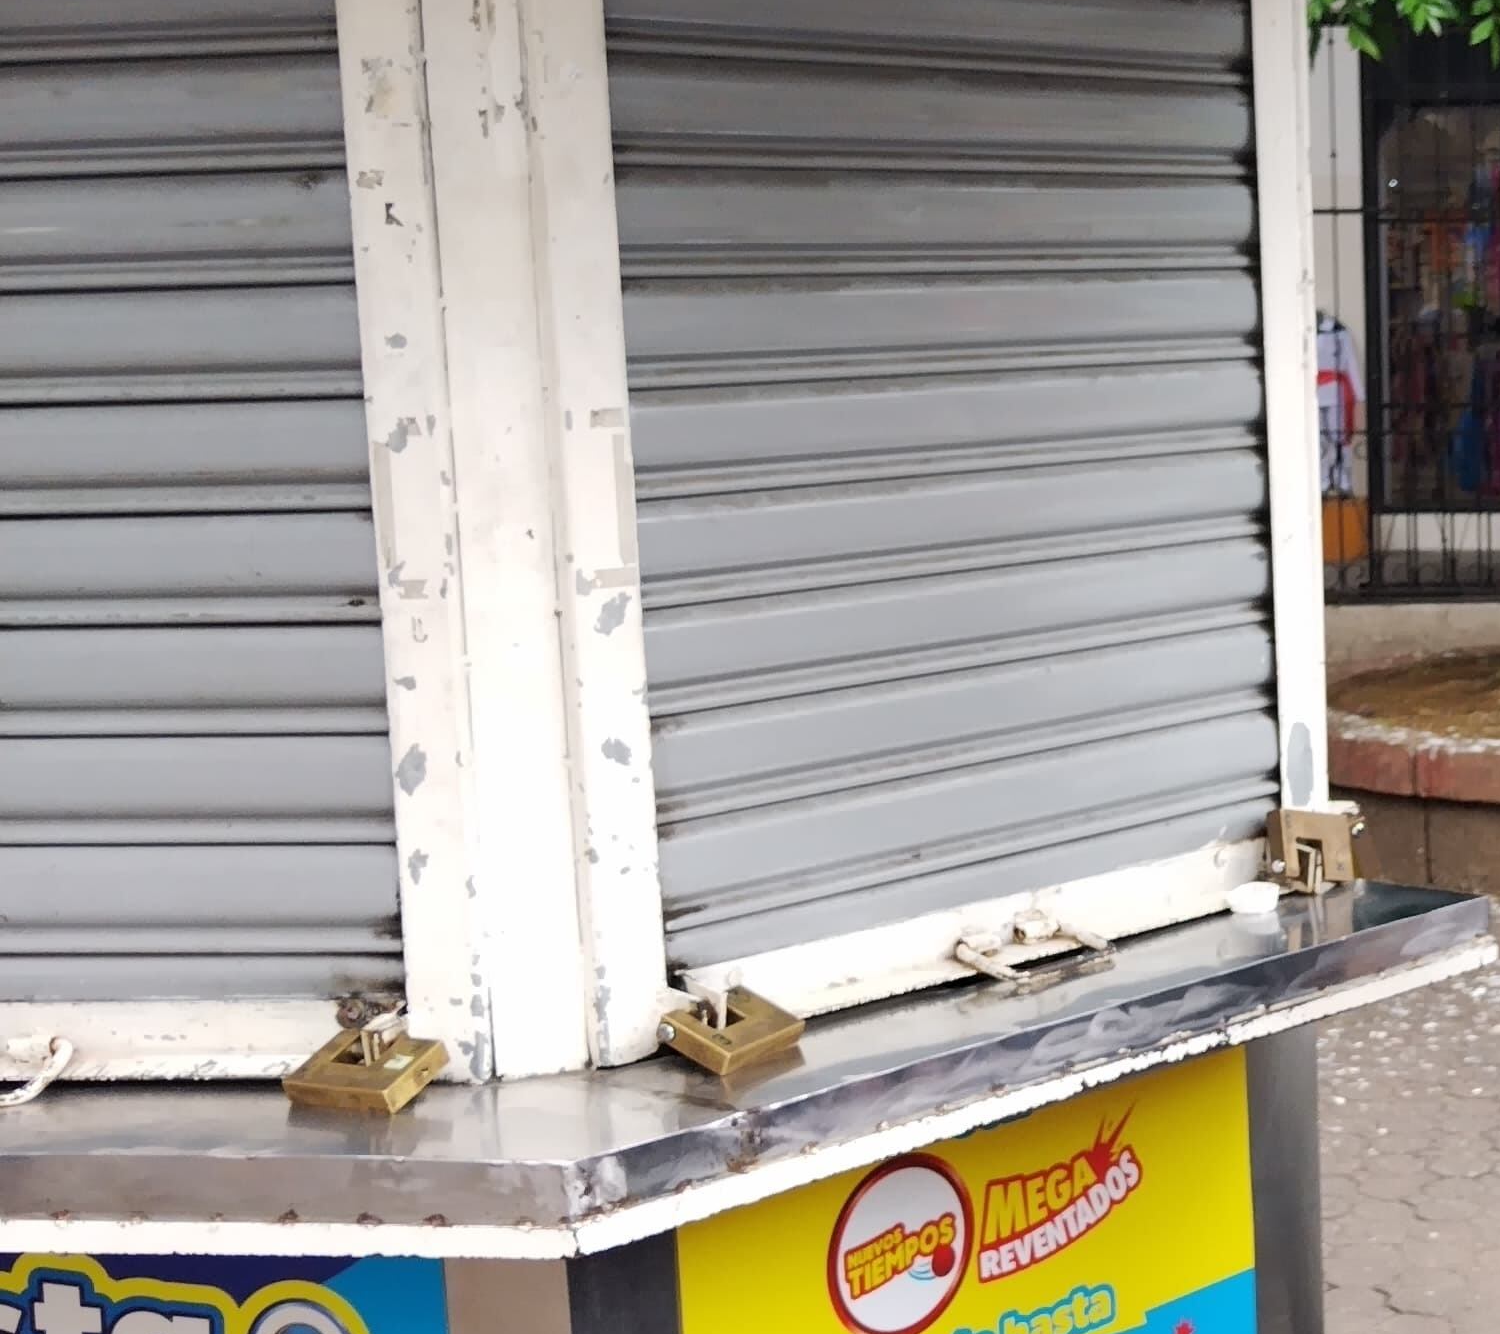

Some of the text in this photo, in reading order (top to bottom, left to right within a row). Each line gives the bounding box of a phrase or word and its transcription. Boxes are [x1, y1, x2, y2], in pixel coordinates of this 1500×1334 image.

[980, 1148, 1140, 1279] REVENTADOS
[982, 1155, 1098, 1245] MEGA
[847, 1215, 955, 1297] TIEMPOS
[848, 1227, 903, 1267] NUEVOS
